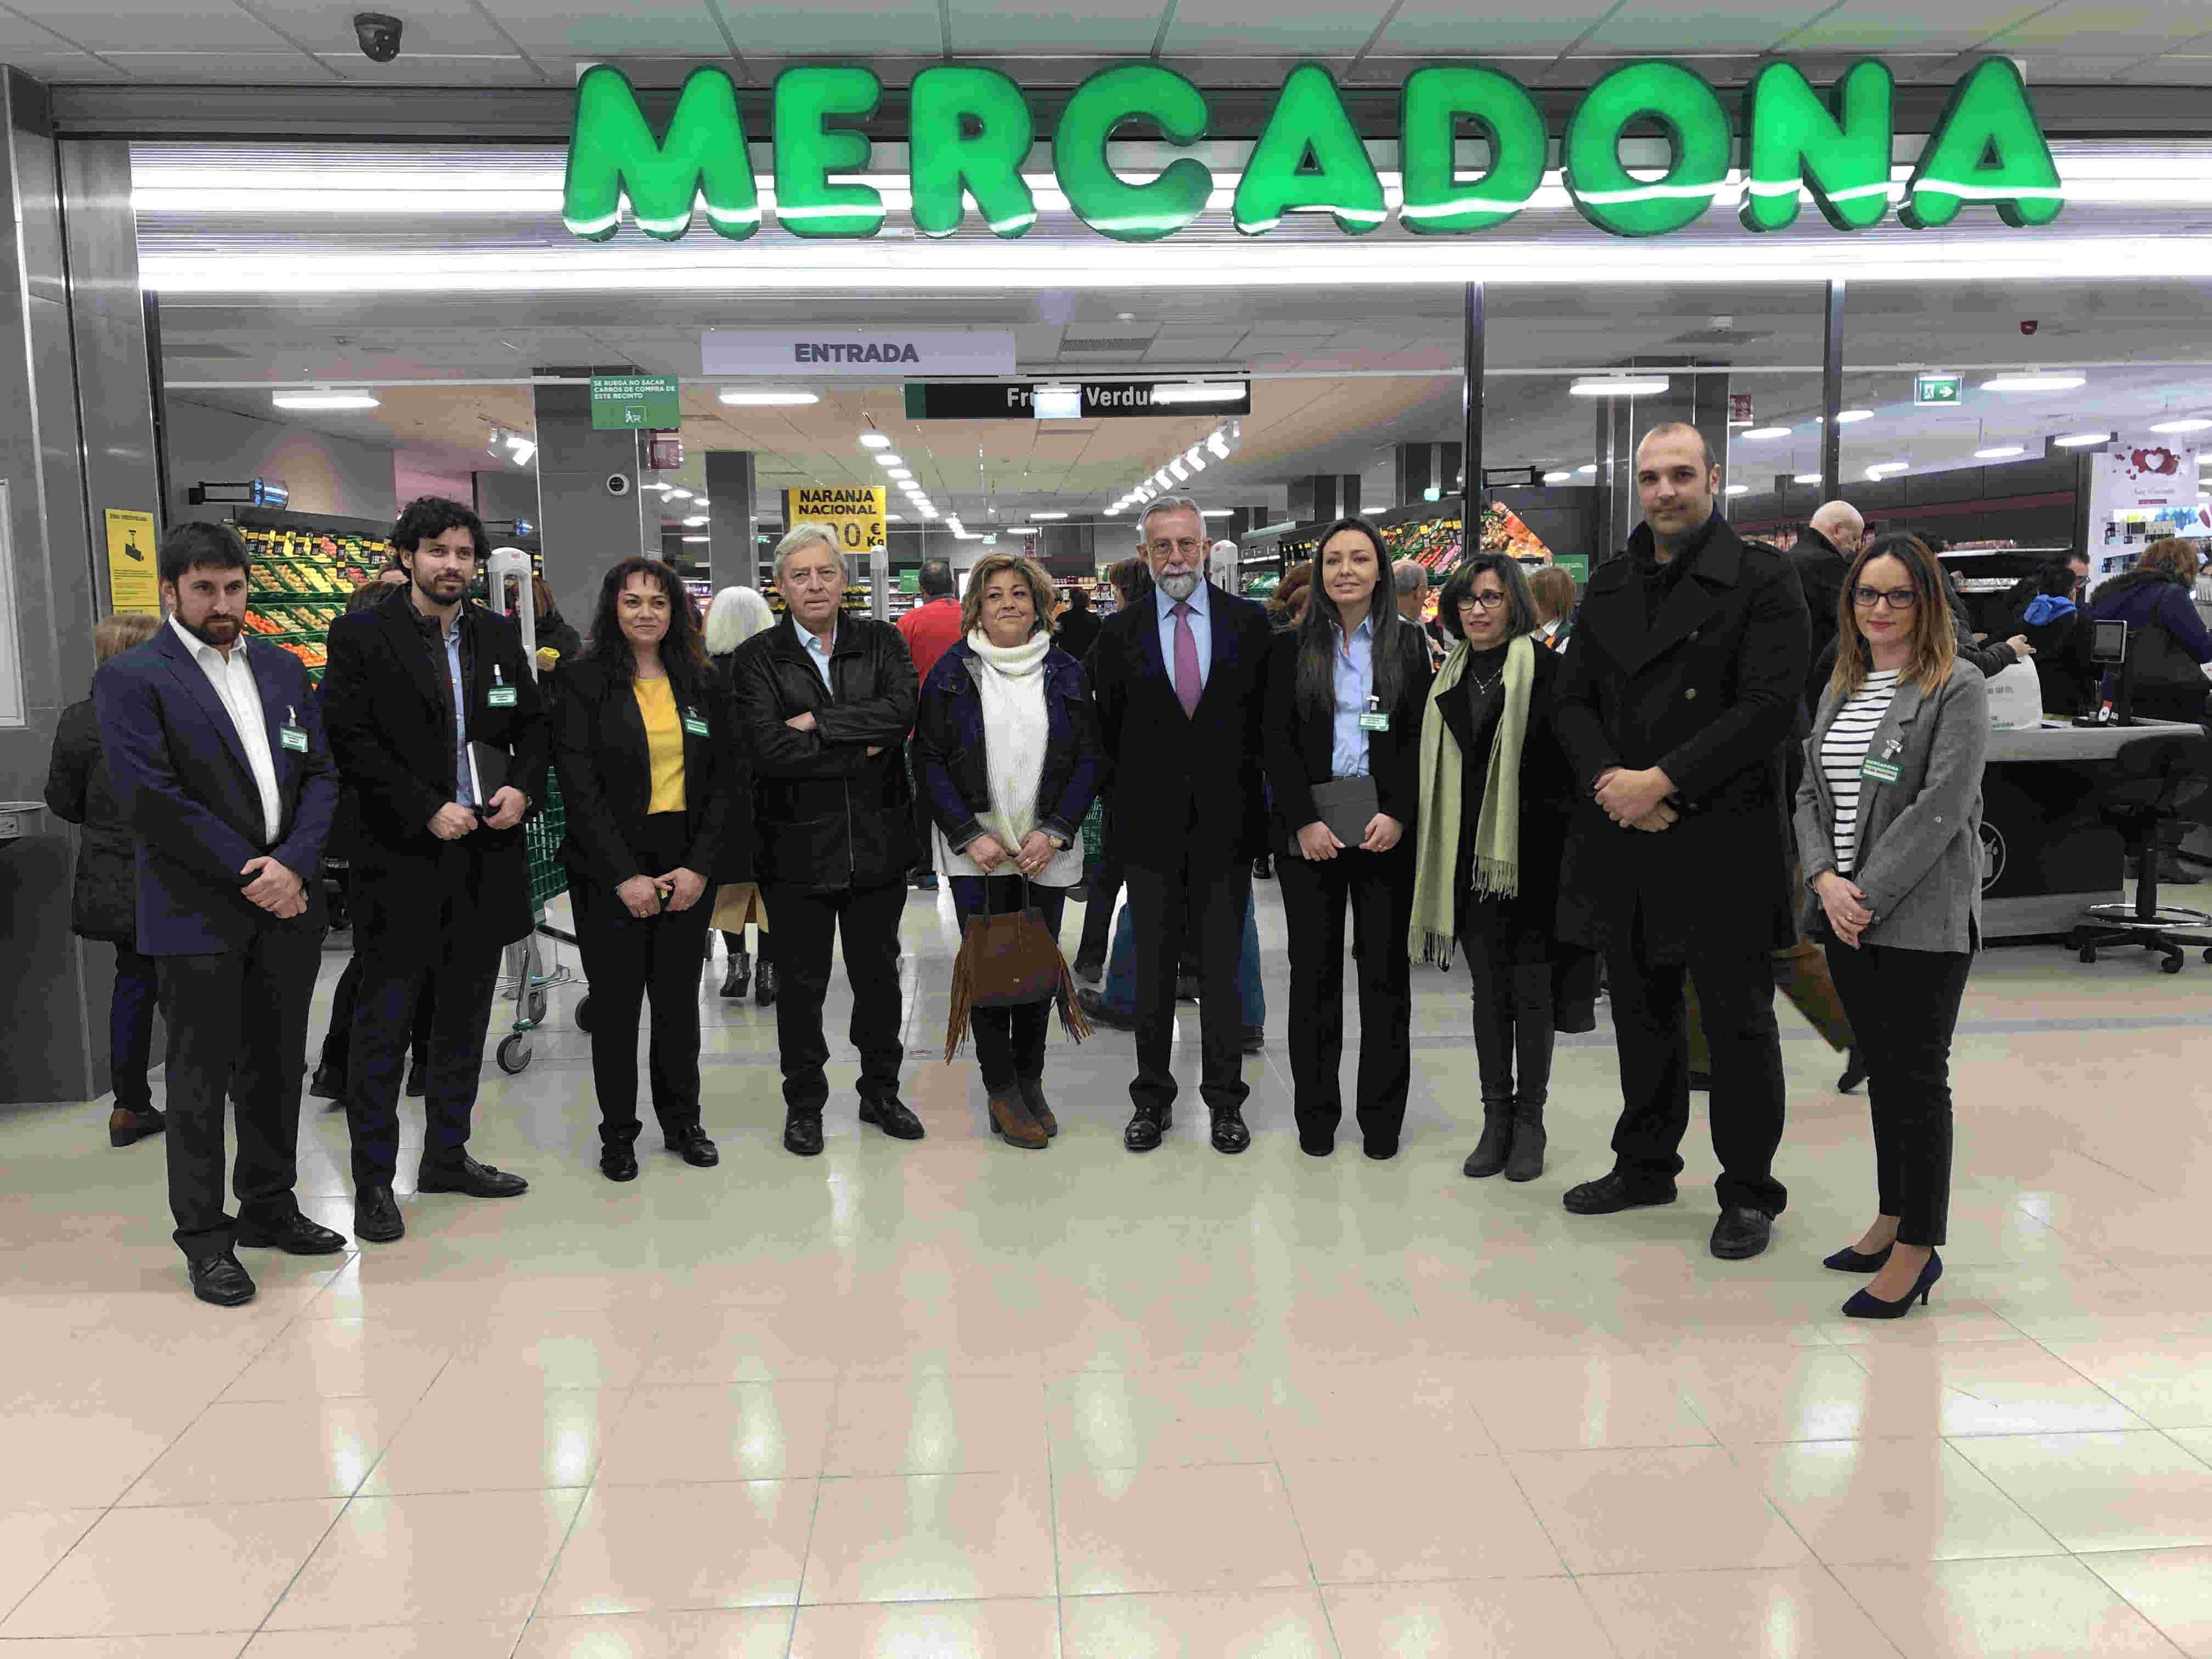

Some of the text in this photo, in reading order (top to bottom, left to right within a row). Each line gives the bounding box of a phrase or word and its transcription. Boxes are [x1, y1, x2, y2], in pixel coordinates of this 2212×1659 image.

[562, 55, 2064, 240] MERCADONA
[794, 343, 920, 363] ENTRADA
[799, 489, 874, 503] NARANJA
[798, 504, 877, 515] NACIONAL
[870, 522, 881, 535] €
